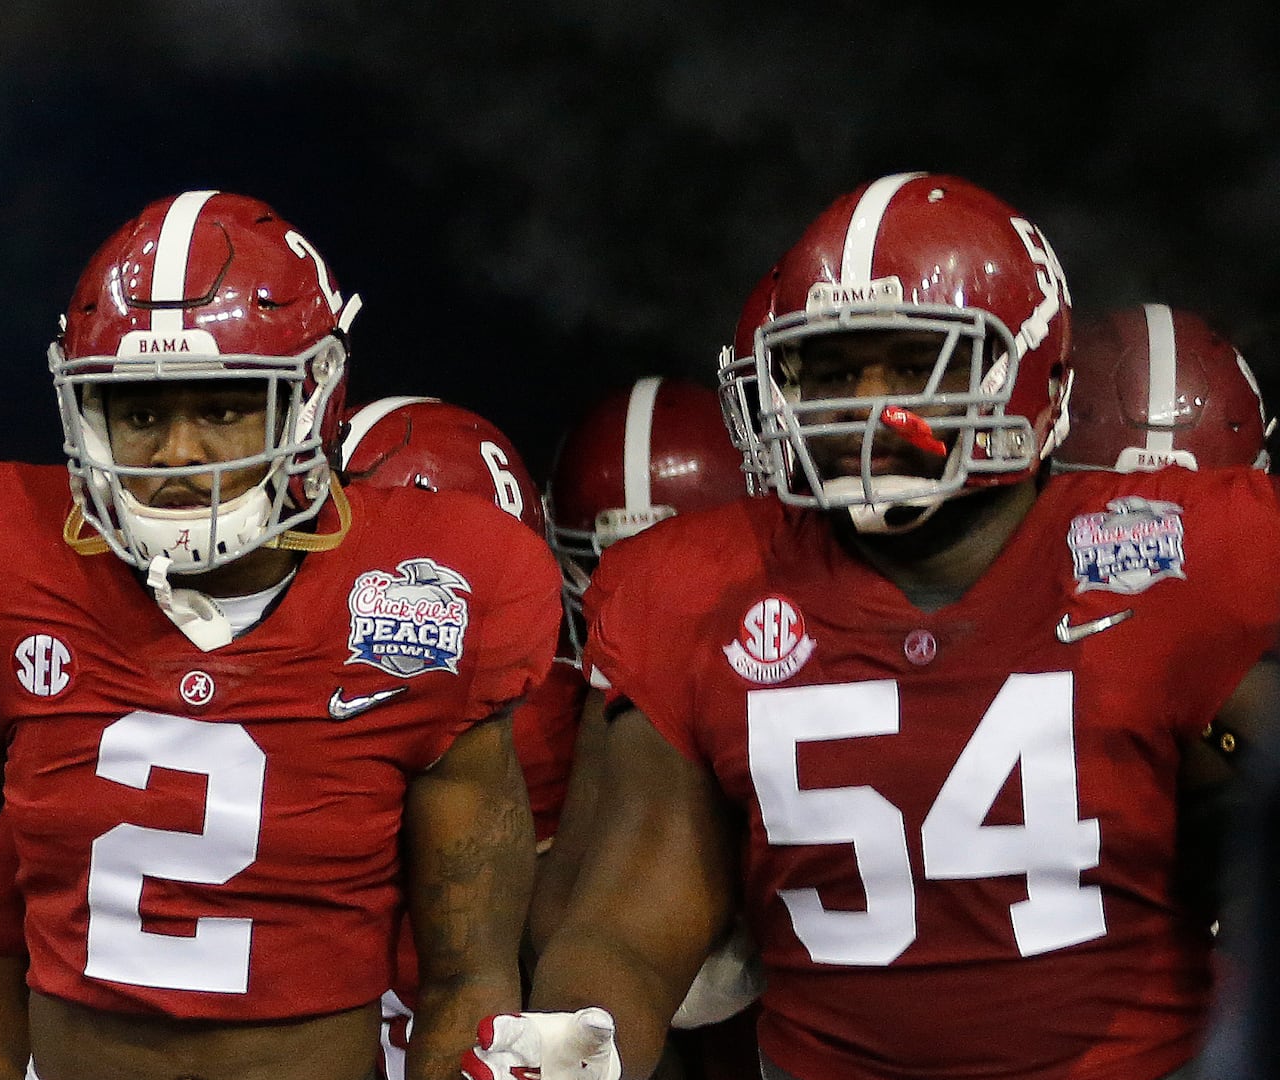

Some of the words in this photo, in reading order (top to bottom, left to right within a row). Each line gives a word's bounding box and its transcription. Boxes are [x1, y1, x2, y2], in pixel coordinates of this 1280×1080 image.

[139, 339, 191, 353] BAMA
[480, 440, 524, 521] 6
[1077, 535, 1178, 574] PEACH
[355, 584, 462, 623] Chick-fil-A
[352, 617, 460, 654] PEACH
[372, 643, 436, 660] BOWL
[743, 598, 799, 662] SEC
[14, 634, 71, 697] SEC
[746, 671, 1109, 968] 54
[84, 710, 267, 995] 2
